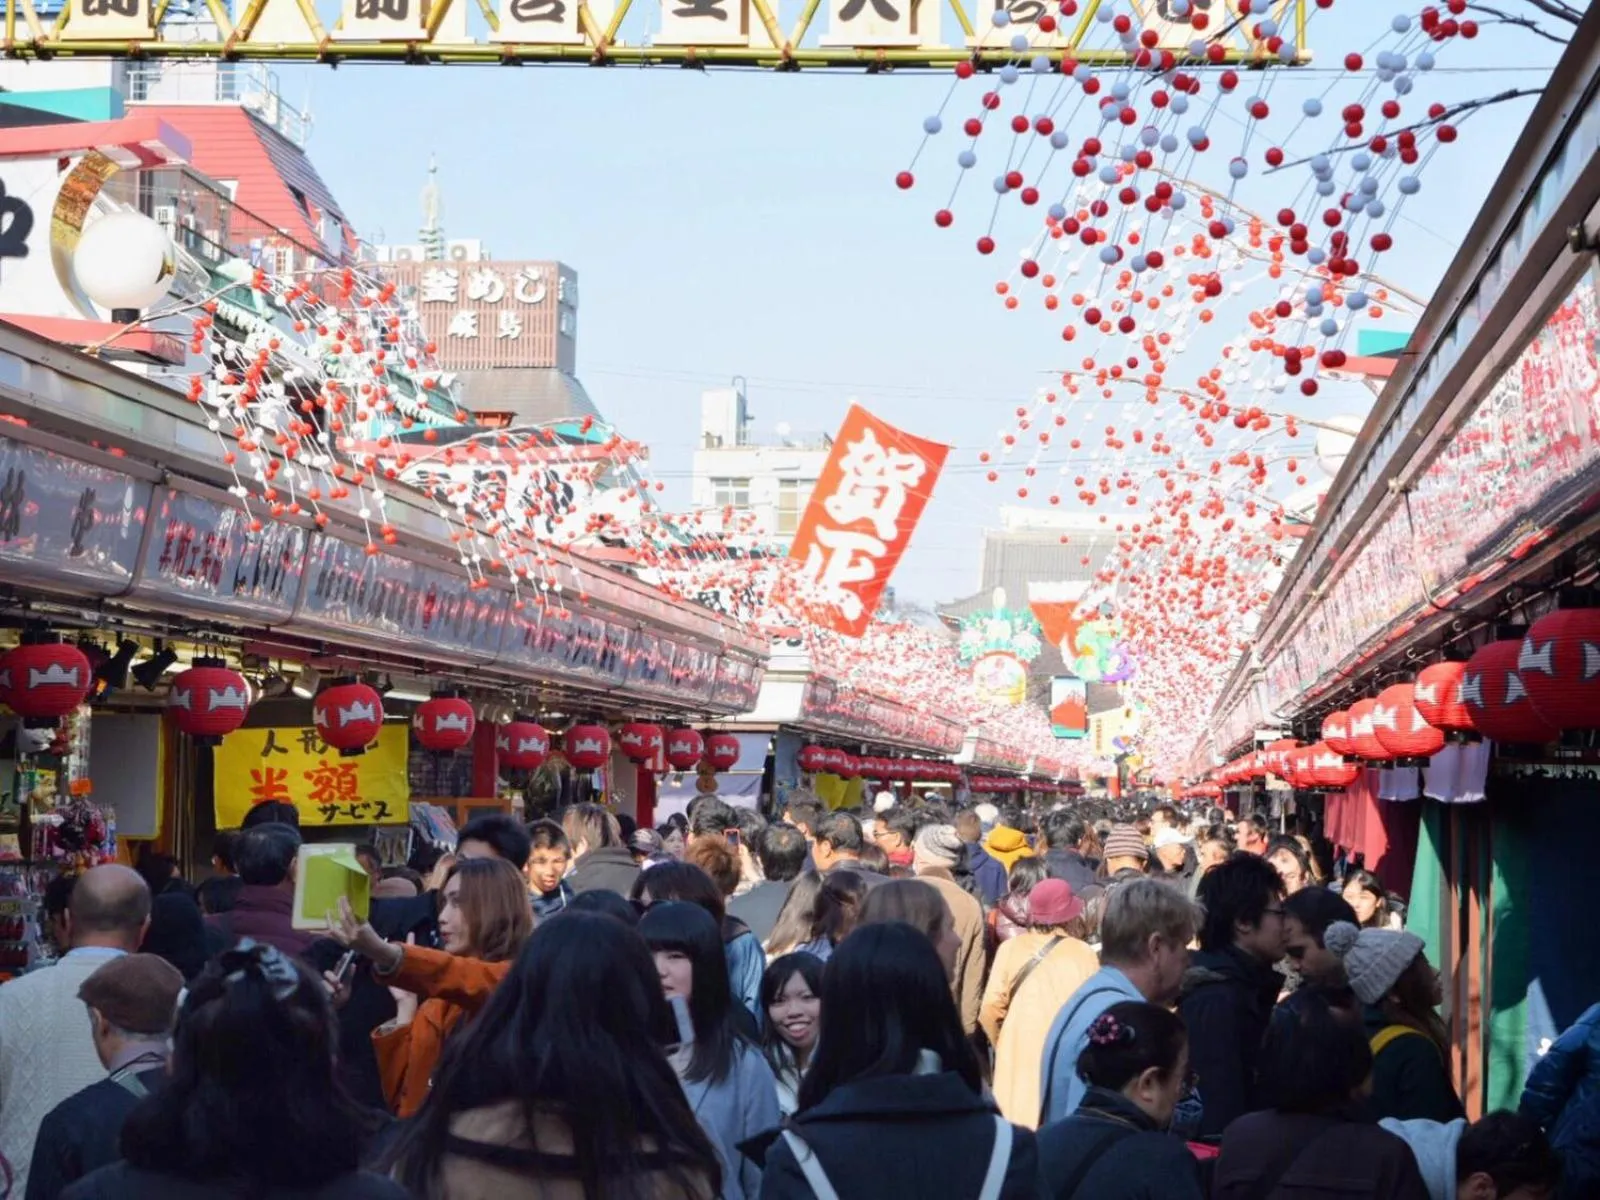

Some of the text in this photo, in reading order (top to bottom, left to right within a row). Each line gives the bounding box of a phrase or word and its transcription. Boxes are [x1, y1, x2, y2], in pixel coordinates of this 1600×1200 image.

[420, 266, 547, 304] 釜めし
[261, 726, 379, 757] 人形
[249, 759, 362, 806] 半額
[318, 800, 393, 822] サービス
